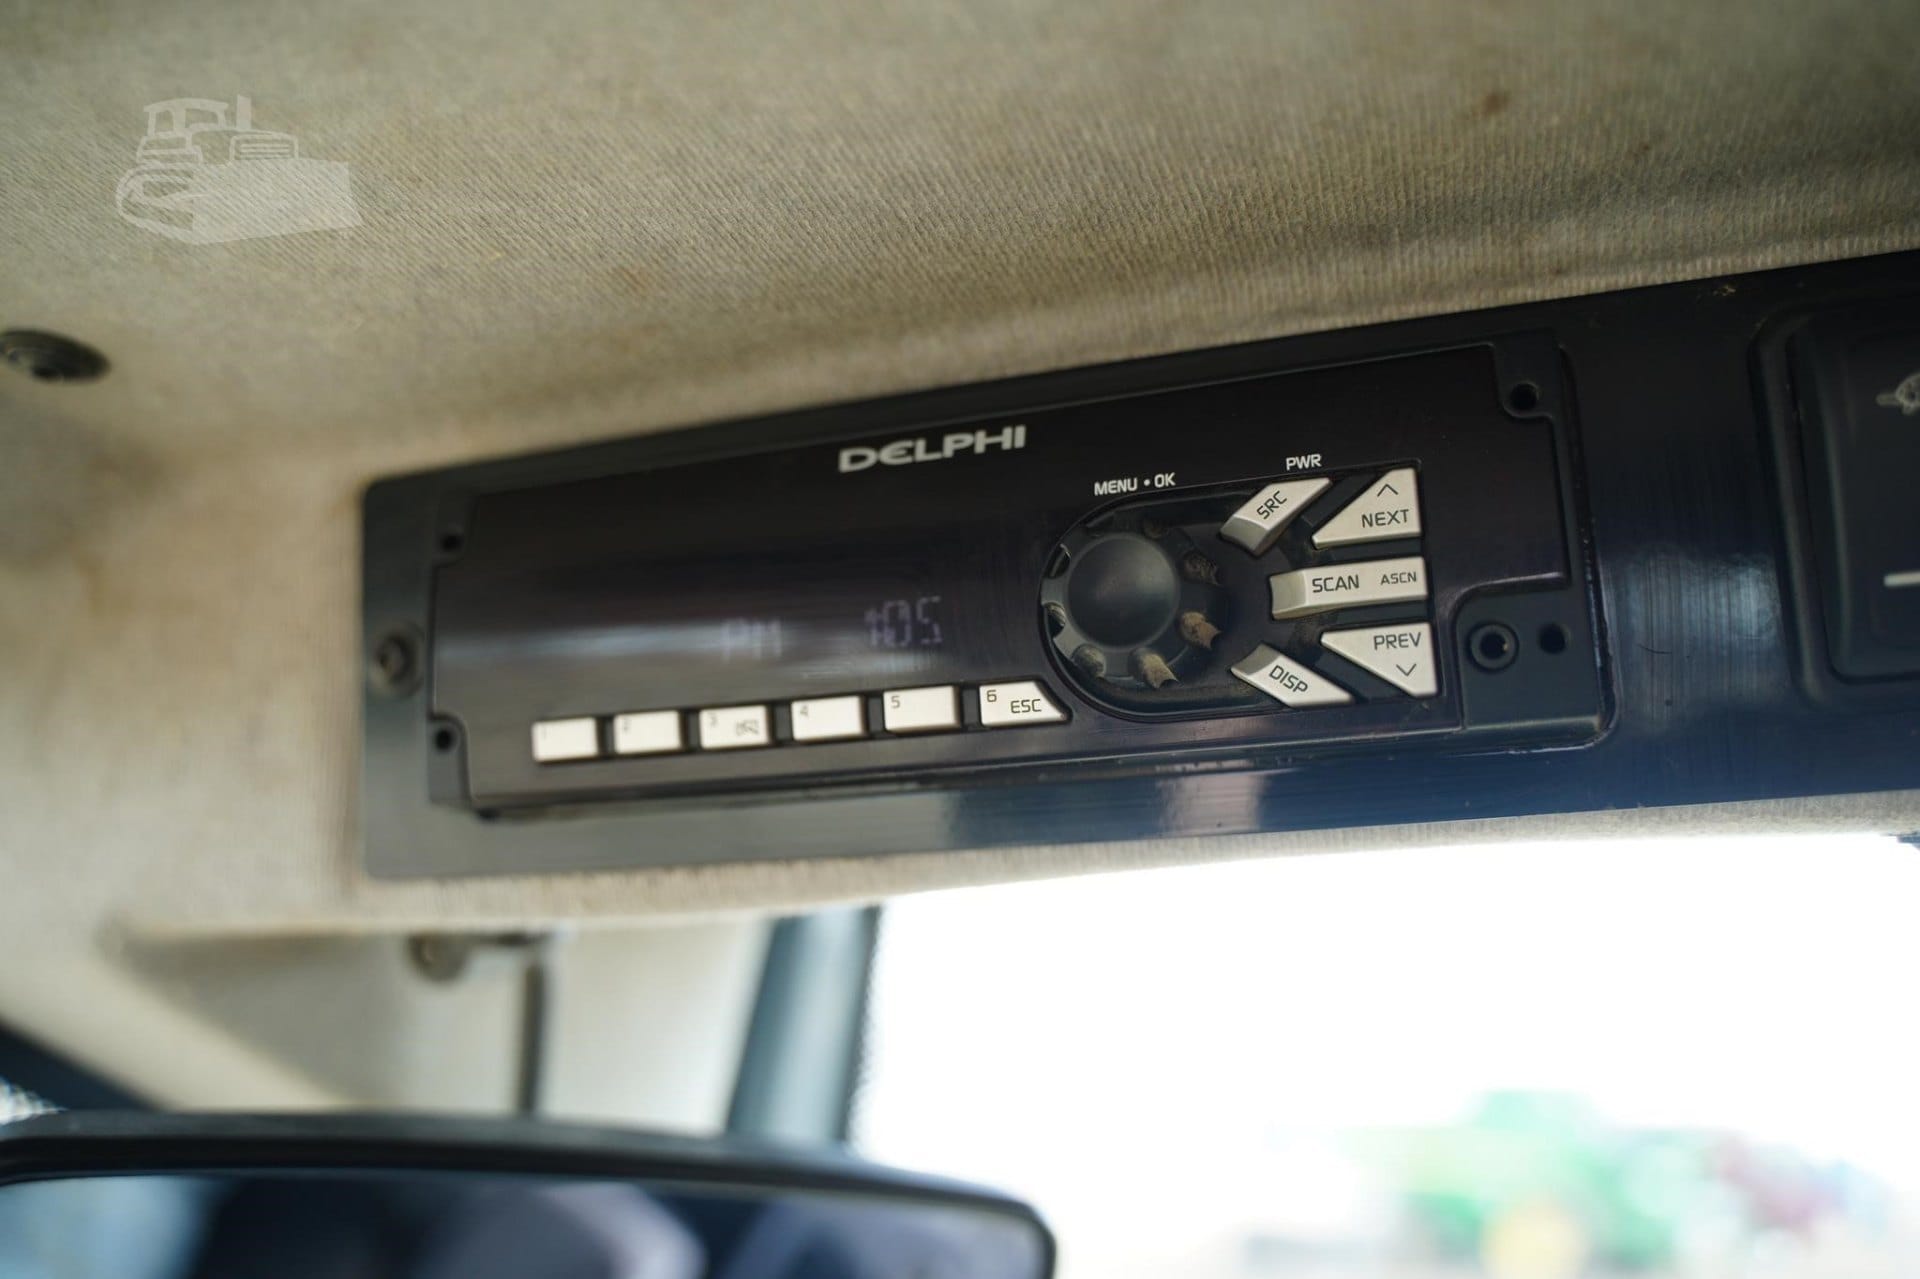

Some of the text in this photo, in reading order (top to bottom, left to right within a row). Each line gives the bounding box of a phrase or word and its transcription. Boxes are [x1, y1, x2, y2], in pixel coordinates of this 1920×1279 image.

[839, 426, 1026, 472] DELPHI
[1286, 453, 1322, 471] PWR
[1094, 472, 1176, 496] MENU OK
[1256, 490, 1287, 520] SRC
[1361, 509, 1409, 528] NEXT
[1312, 571, 1417, 593] SCAN ASCN
[1373, 632, 1421, 650] PREV
[1268, 665, 1309, 693] DISP
[890, 696, 901, 710] 5
[985, 689, 1042, 714] 6 ESC
